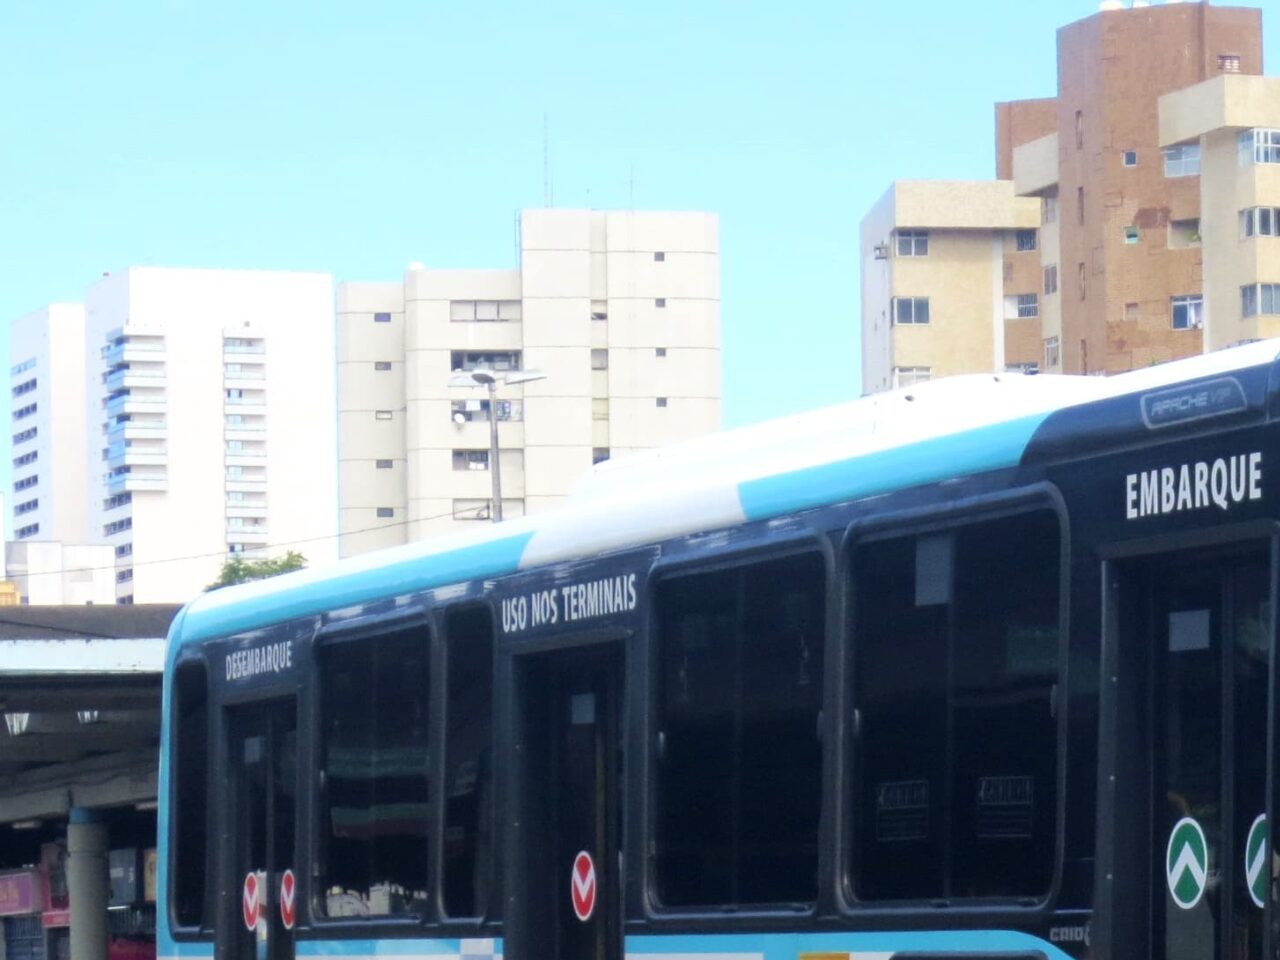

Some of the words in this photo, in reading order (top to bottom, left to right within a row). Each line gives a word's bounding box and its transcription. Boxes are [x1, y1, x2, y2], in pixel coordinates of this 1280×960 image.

[1151, 391, 1208, 416] APACHE
[1125, 451, 1262, 520] EMBARQUE
[502, 598, 527, 633] USO
[531, 589, 557, 628] NOS
[562, 573, 637, 621] TERMINAIS
[225, 639, 293, 681] DESEMBARQUE
[1049, 926, 1084, 942] CAIO
